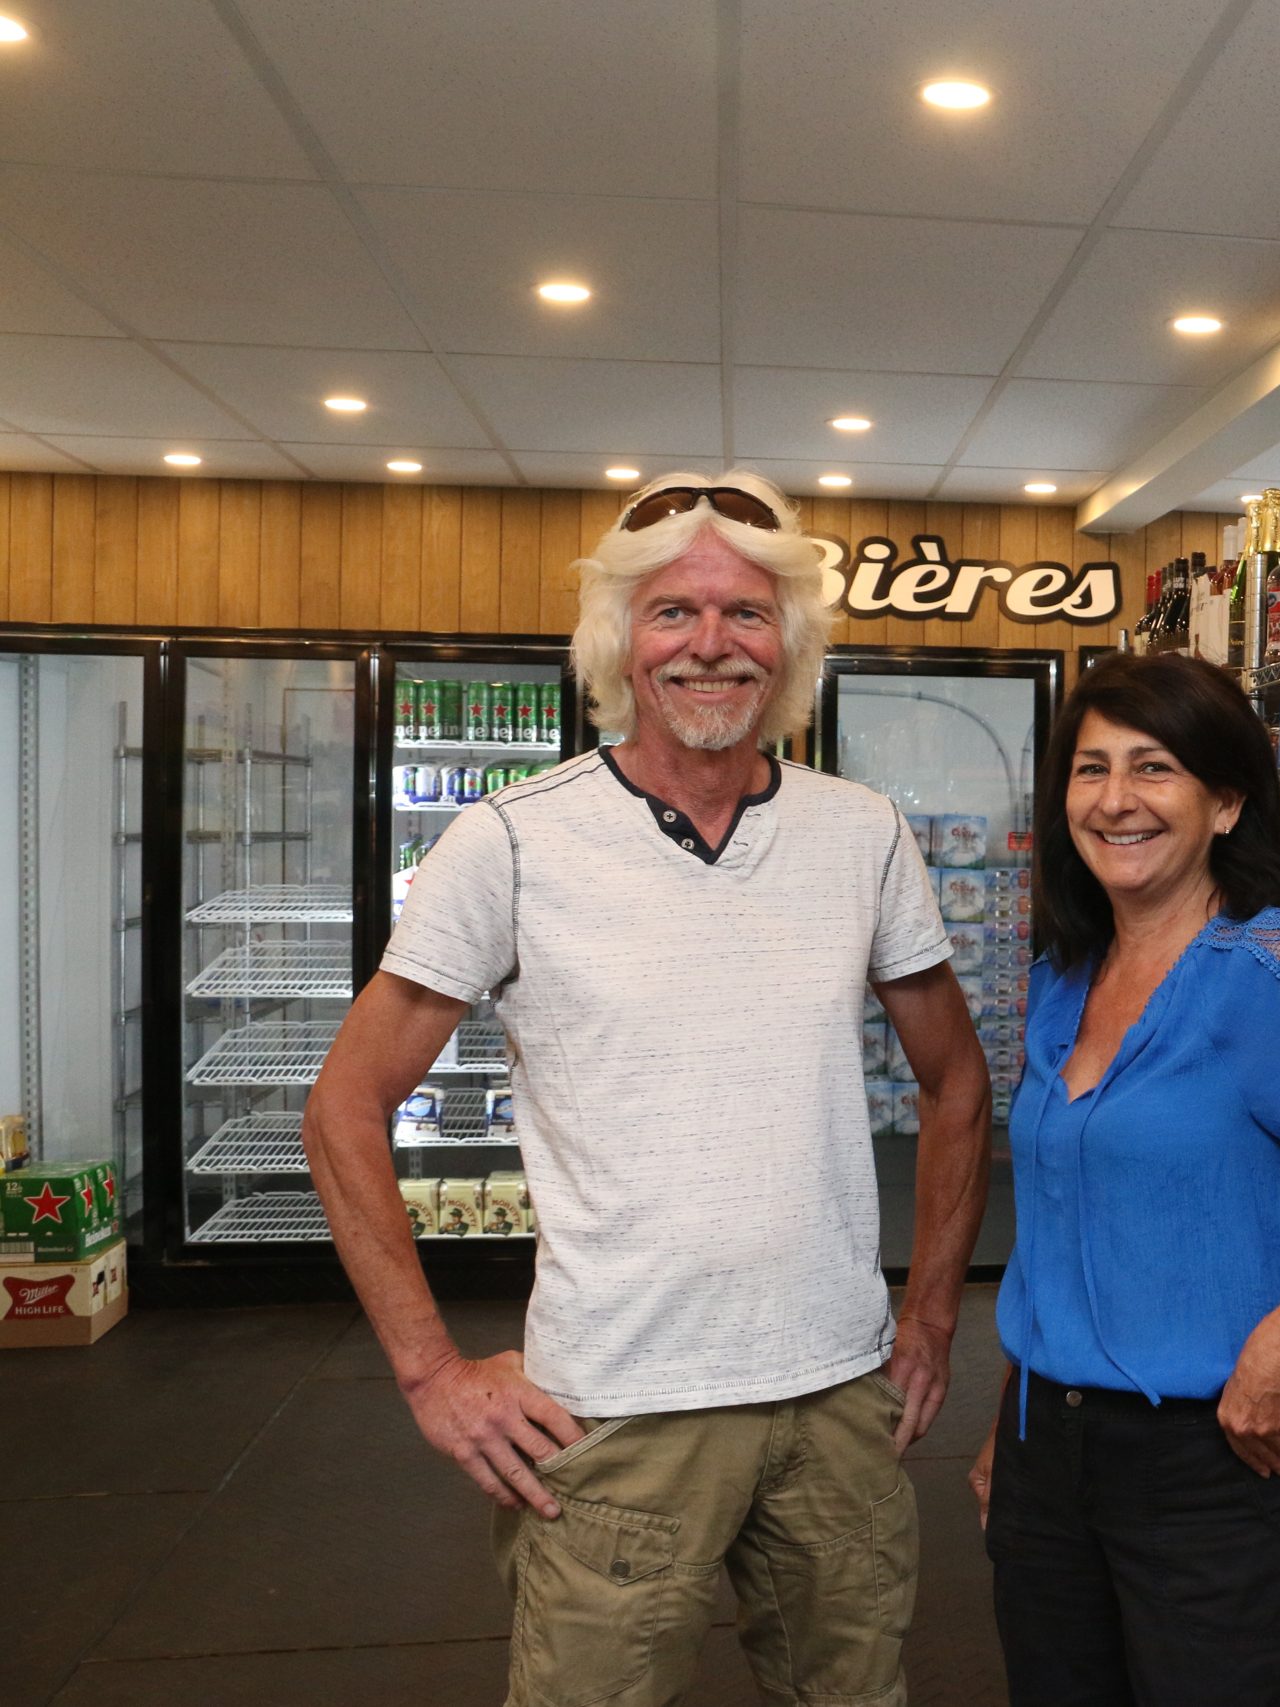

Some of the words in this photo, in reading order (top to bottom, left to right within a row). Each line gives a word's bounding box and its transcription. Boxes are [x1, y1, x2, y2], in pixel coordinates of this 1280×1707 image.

[806, 537, 1116, 619] Bières
[19, 1285, 60, 1305] Miller
[15, 1306, 41, 1315] HIGH
[42, 1305, 65, 1314] LIFE
